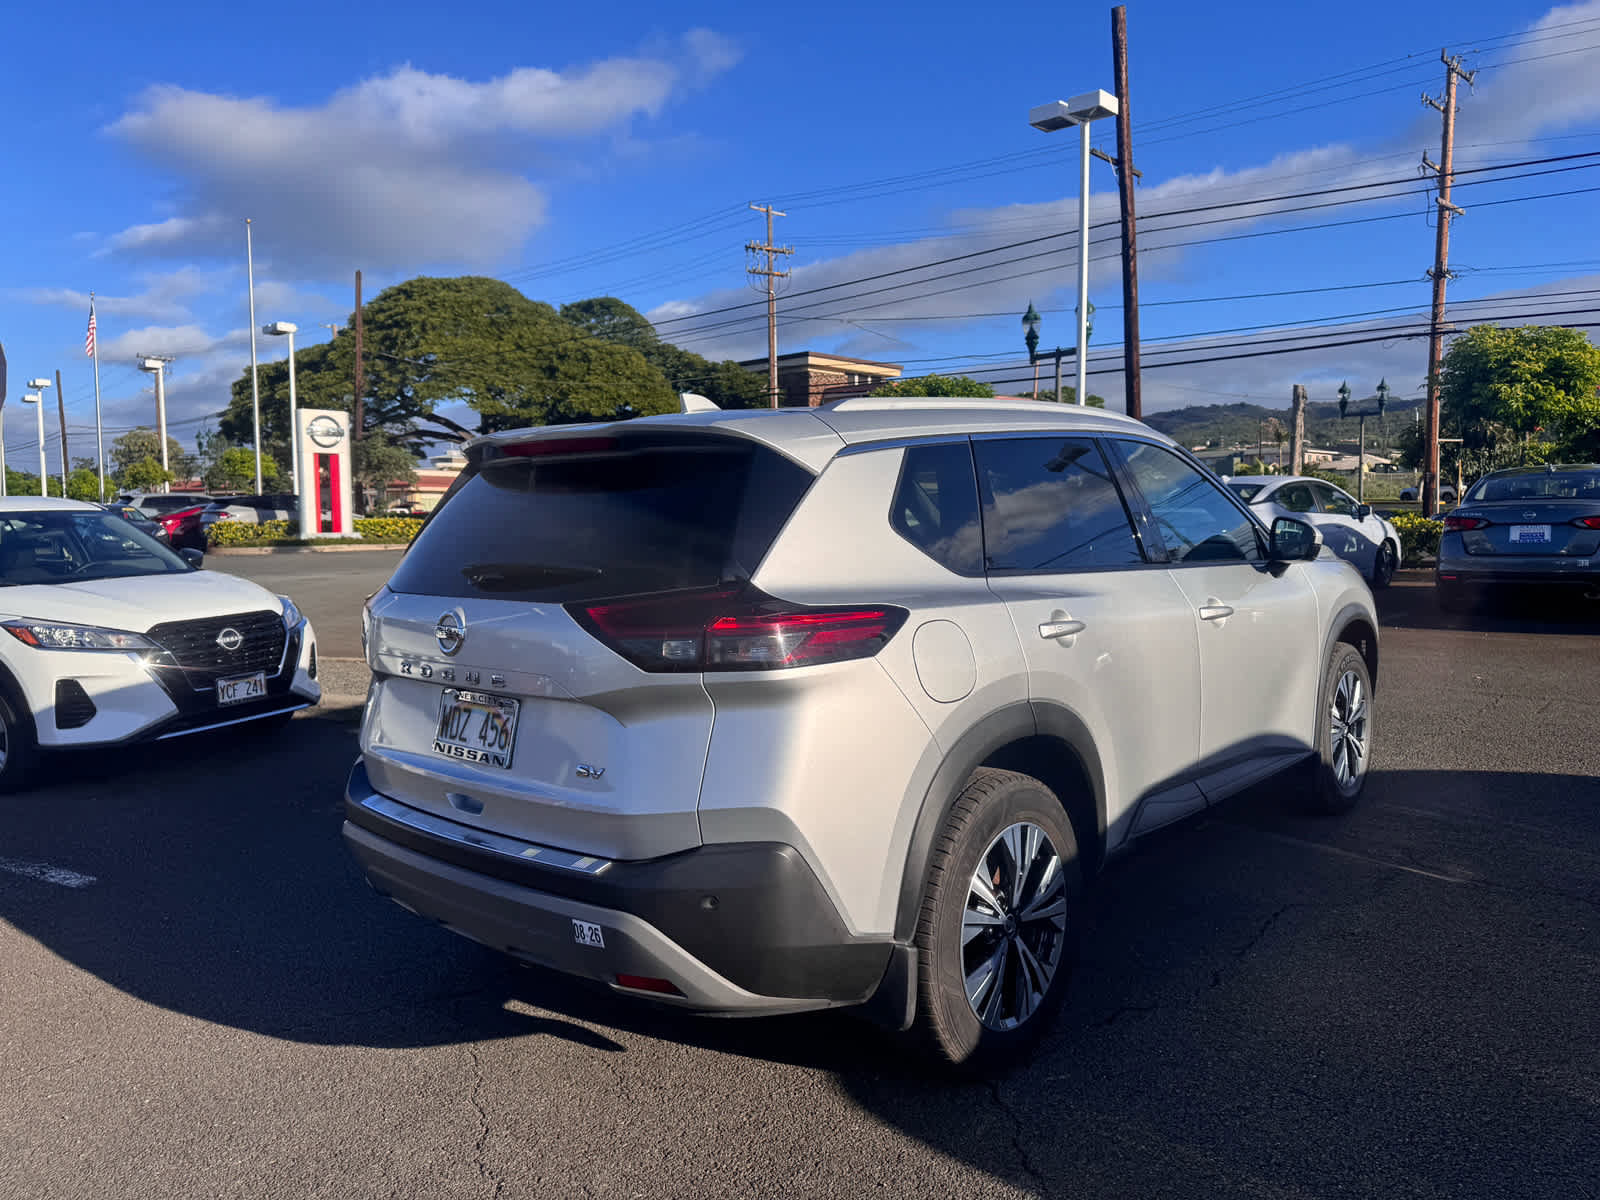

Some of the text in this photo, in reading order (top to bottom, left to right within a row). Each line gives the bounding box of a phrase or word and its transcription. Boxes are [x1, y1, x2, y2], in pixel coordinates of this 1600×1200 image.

[400, 661, 506, 688] ROGUE
[479, 712, 510, 750] 456
[434, 742, 505, 766] NISSAN
[576, 764, 606, 780] SV
